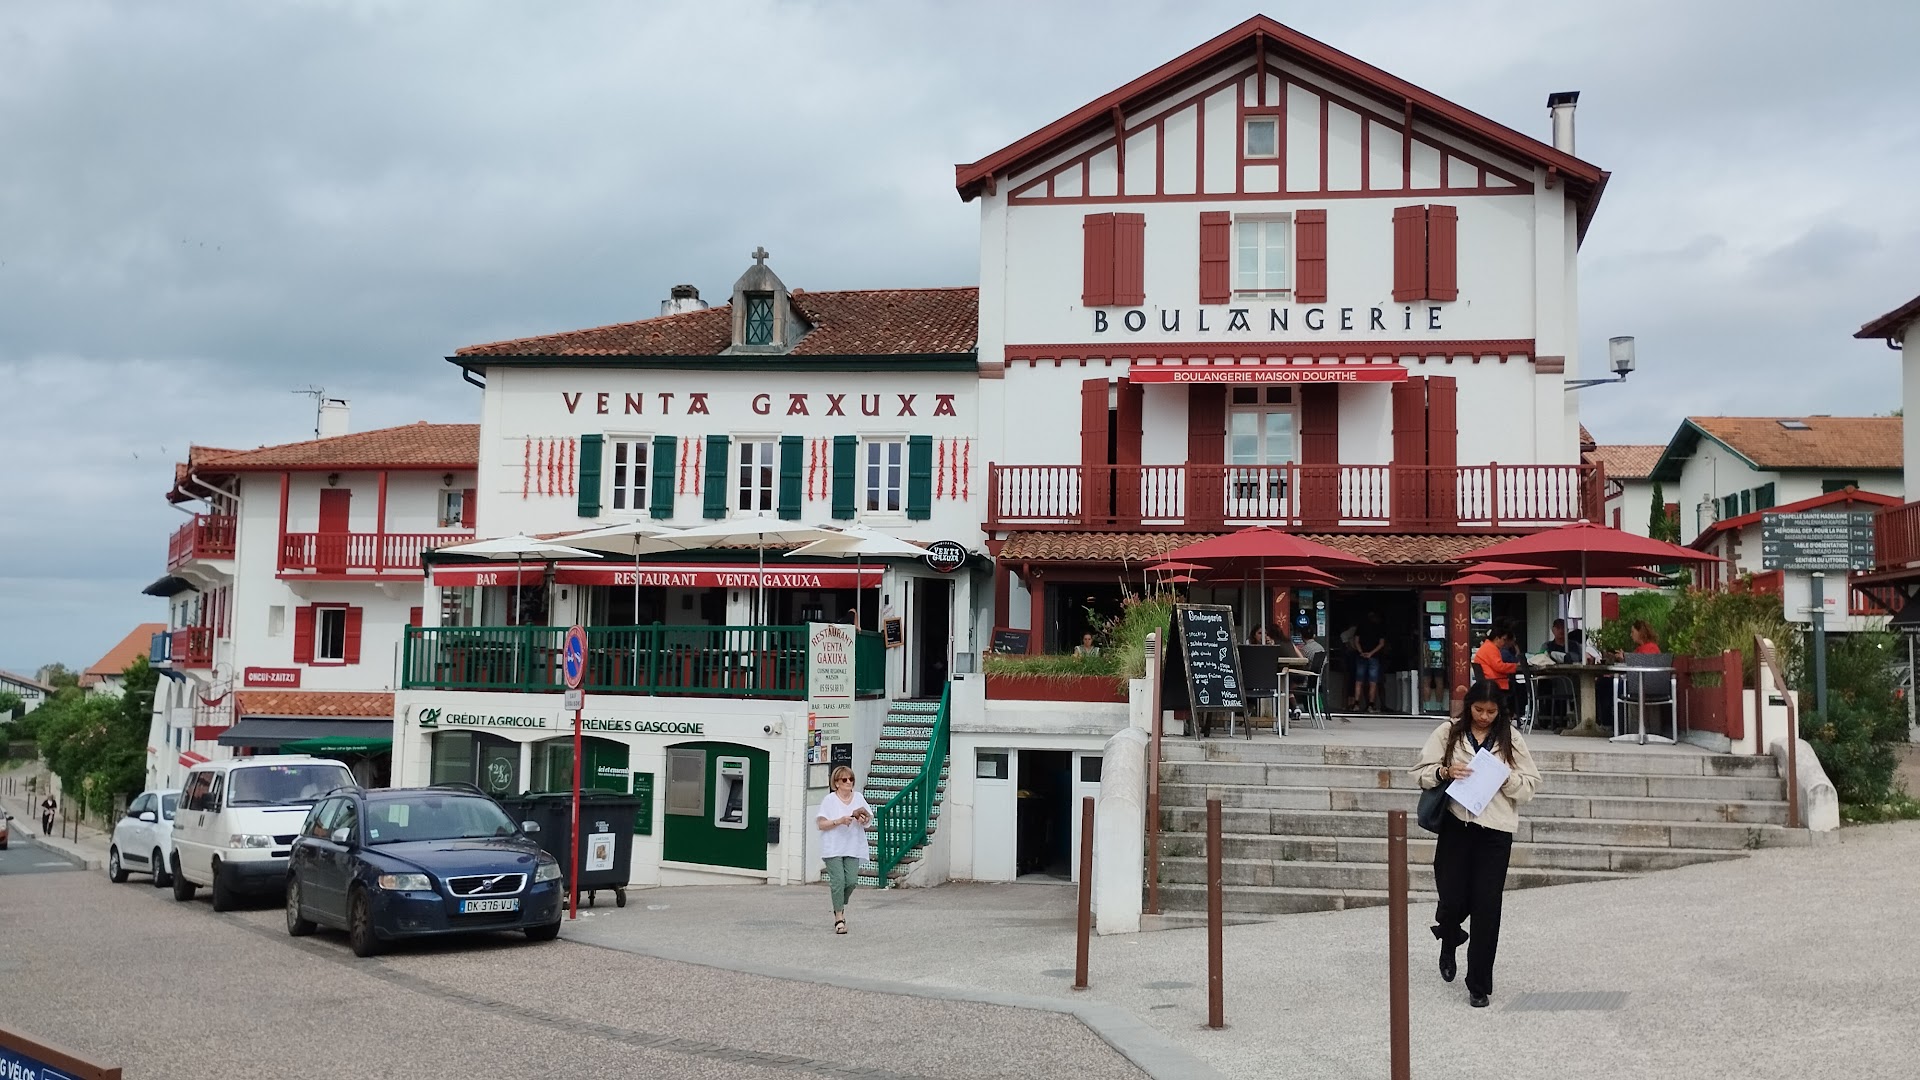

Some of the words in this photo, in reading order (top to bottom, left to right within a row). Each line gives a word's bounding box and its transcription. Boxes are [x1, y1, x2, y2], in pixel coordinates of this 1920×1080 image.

[1173, 372, 1252, 382] BOULANGERIE
[1255, 371, 1300, 381] MAISON
[1302, 371, 1357, 381] DOURTHE
[562, 392, 710, 415] VENTA
[752, 393, 957, 417] GAXUXA
[934, 546, 959, 555] VENTA
[476, 573, 498, 586] BAR
[614, 572, 698, 586] RESTAURANT
[716, 573, 759, 586] VENTA
[762, 574, 821, 587] GAXUXA
[1188, 610, 1222, 623] Boulangerie
[811, 626, 853, 646] RESTAURANT
[822, 642, 842, 651] VENTA
[817, 652, 848, 665] GAXUXA
[446, 712, 487, 725] CRÉDIT
[487, 716, 546, 727] AGRICOLE
[570, 717, 632, 730] PRÉNÉES
[634, 720, 704, 733] GASCOGNE
[8, 1060, 36, 1080] VÉLOS
